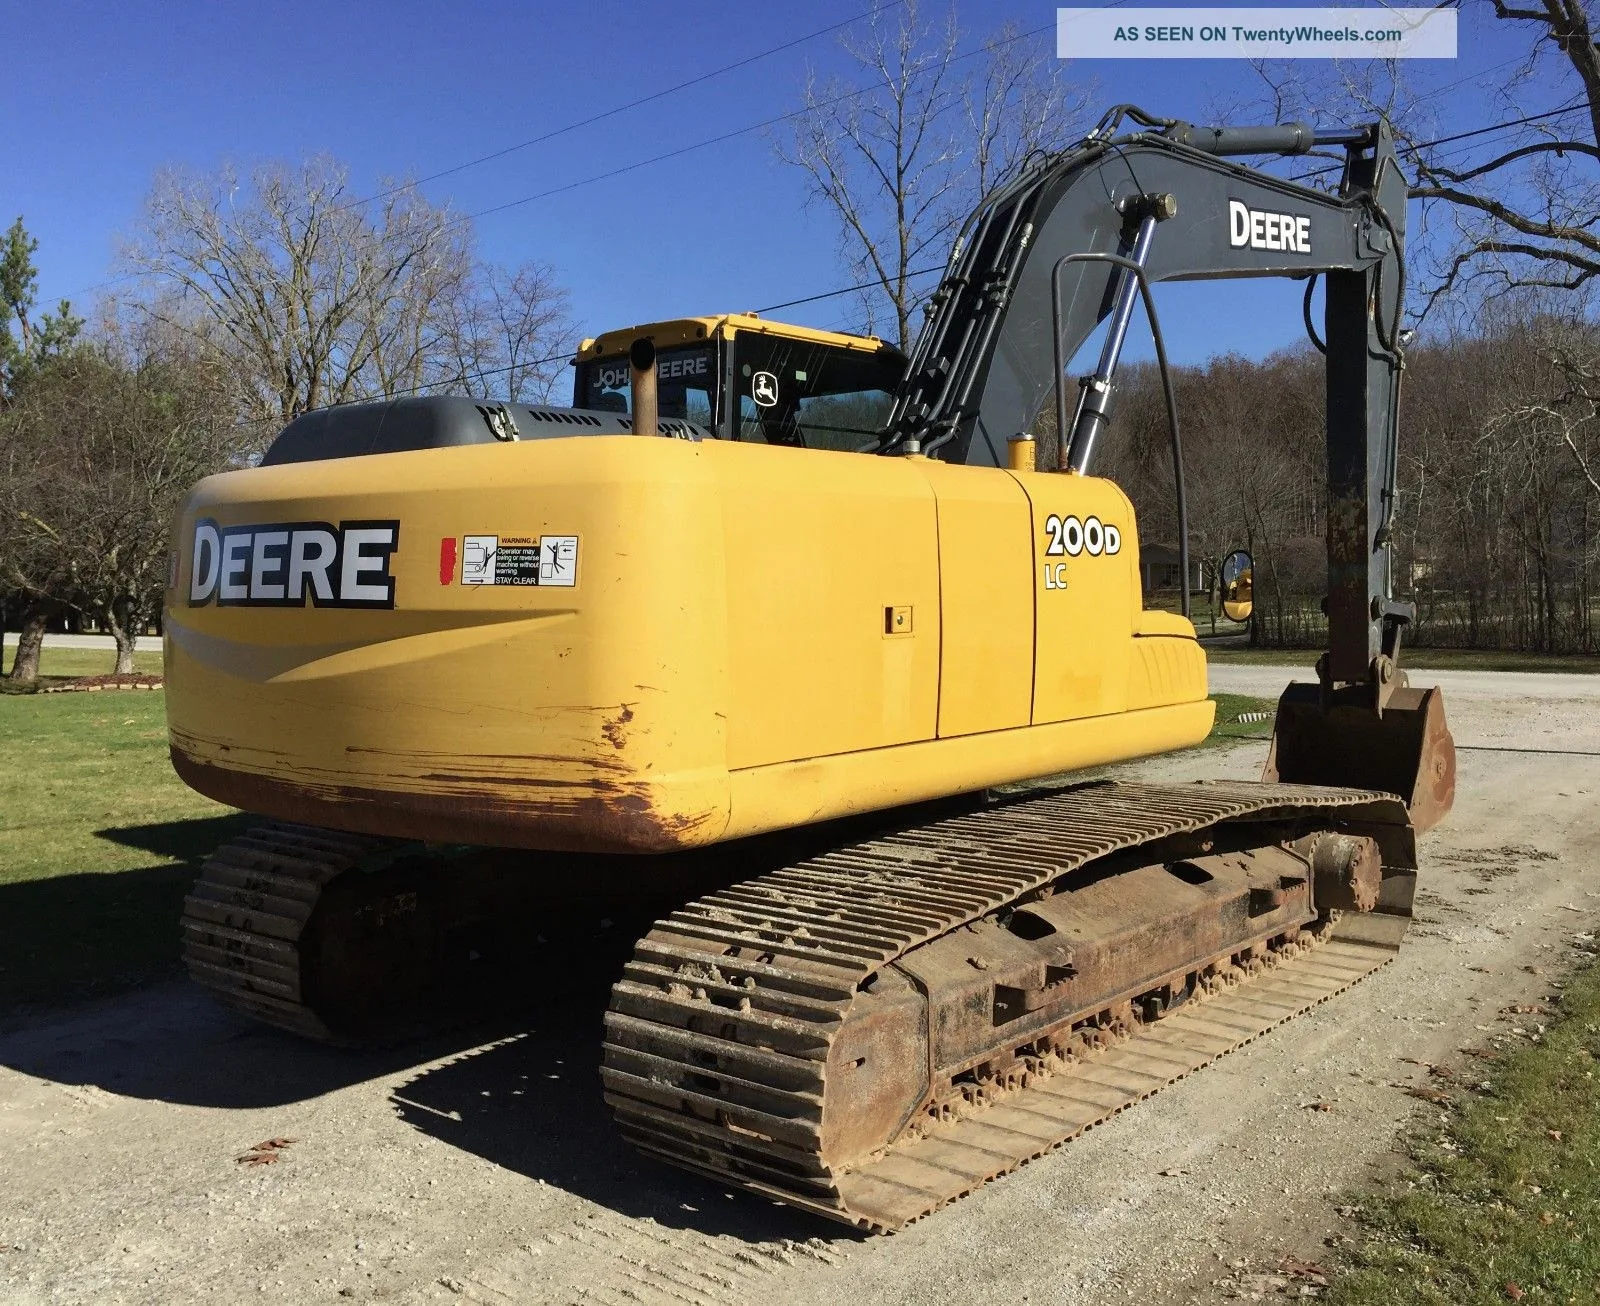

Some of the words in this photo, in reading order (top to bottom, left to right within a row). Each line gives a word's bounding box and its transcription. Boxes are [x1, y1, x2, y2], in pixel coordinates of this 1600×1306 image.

[1229, 200, 1311, 253] DEERE
[656, 357, 708, 379] EERE
[1045, 513, 1121, 557] 200D
[191, 524, 394, 602] DEERE
[1045, 563, 1067, 590] LC
[495, 577, 512, 585] STAY
[512, 577, 536, 585] CLEAR
